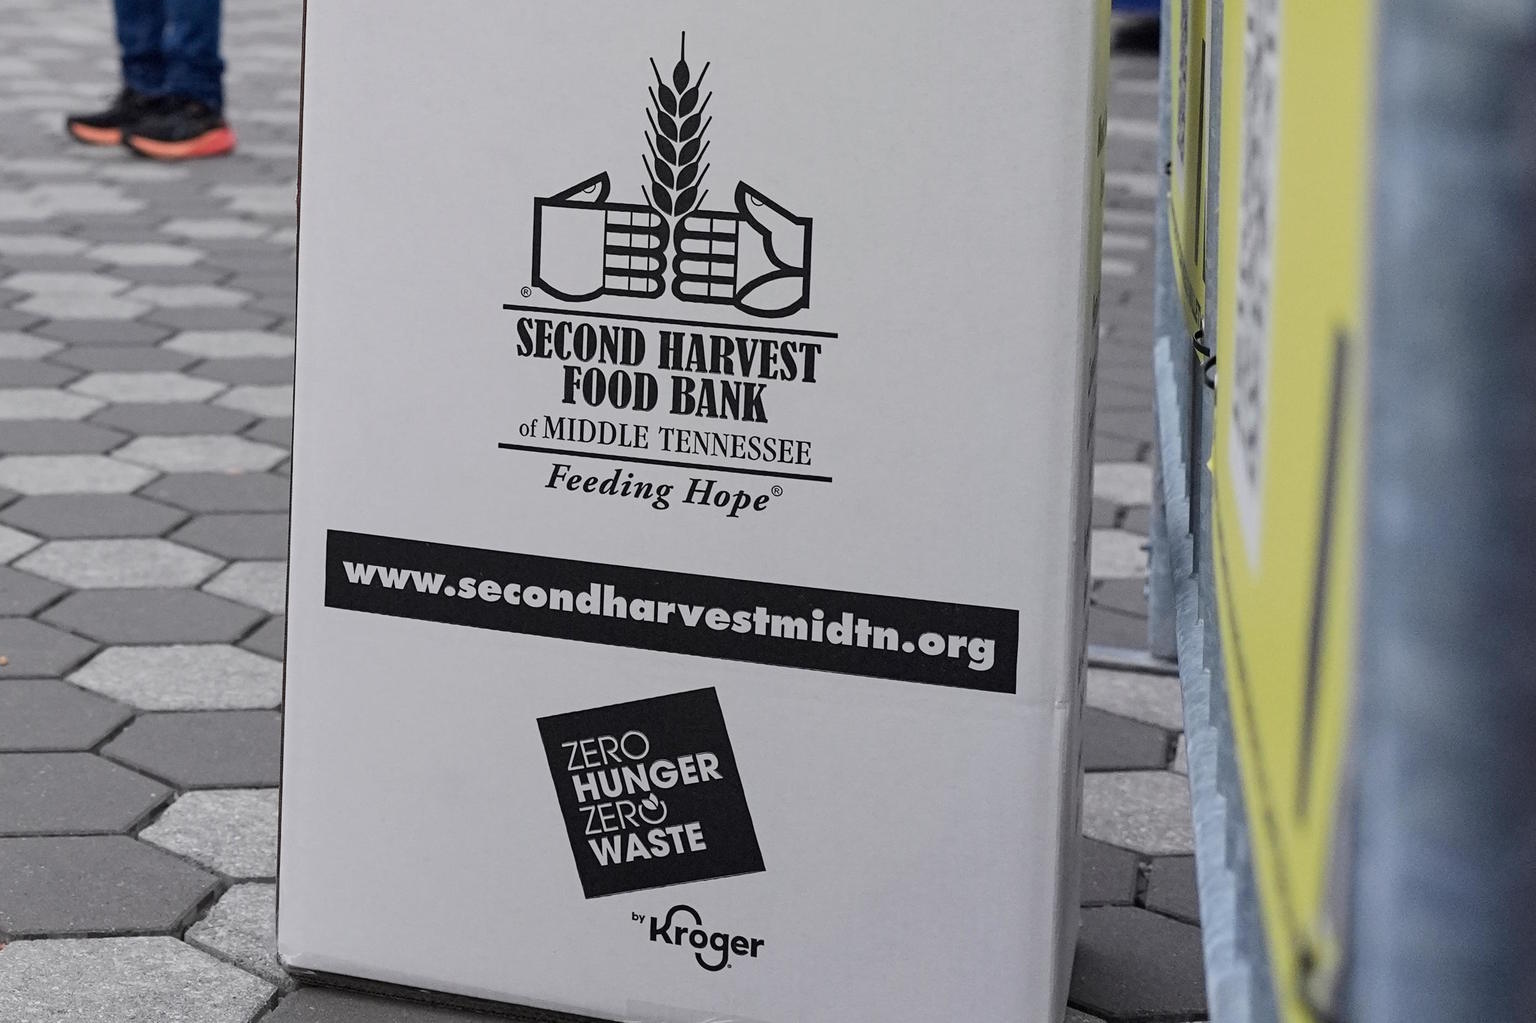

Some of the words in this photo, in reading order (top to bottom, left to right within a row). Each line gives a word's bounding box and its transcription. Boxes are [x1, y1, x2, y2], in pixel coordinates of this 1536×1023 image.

[516, 317, 646, 367] SECOND
[657, 330, 822, 384] HARVEST
[561, 364, 659, 412] FOOD
[669, 375, 769, 424] BANK
[519, 418, 539, 438] of
[542, 415, 649, 450] MIDDLE
[658, 426, 812, 466] TENNESSEE
[544, 463, 674, 511] Feeding
[342, 560, 996, 671] www.secondharvestmidtn.org
[561, 730, 650, 771] ZERO
[571, 752, 724, 803] HUNGER
[578, 795, 668, 836] ZERO
[587, 821, 707, 867] WASTE
[631, 911, 646, 924] by
[649, 904, 765, 972] Kroger
